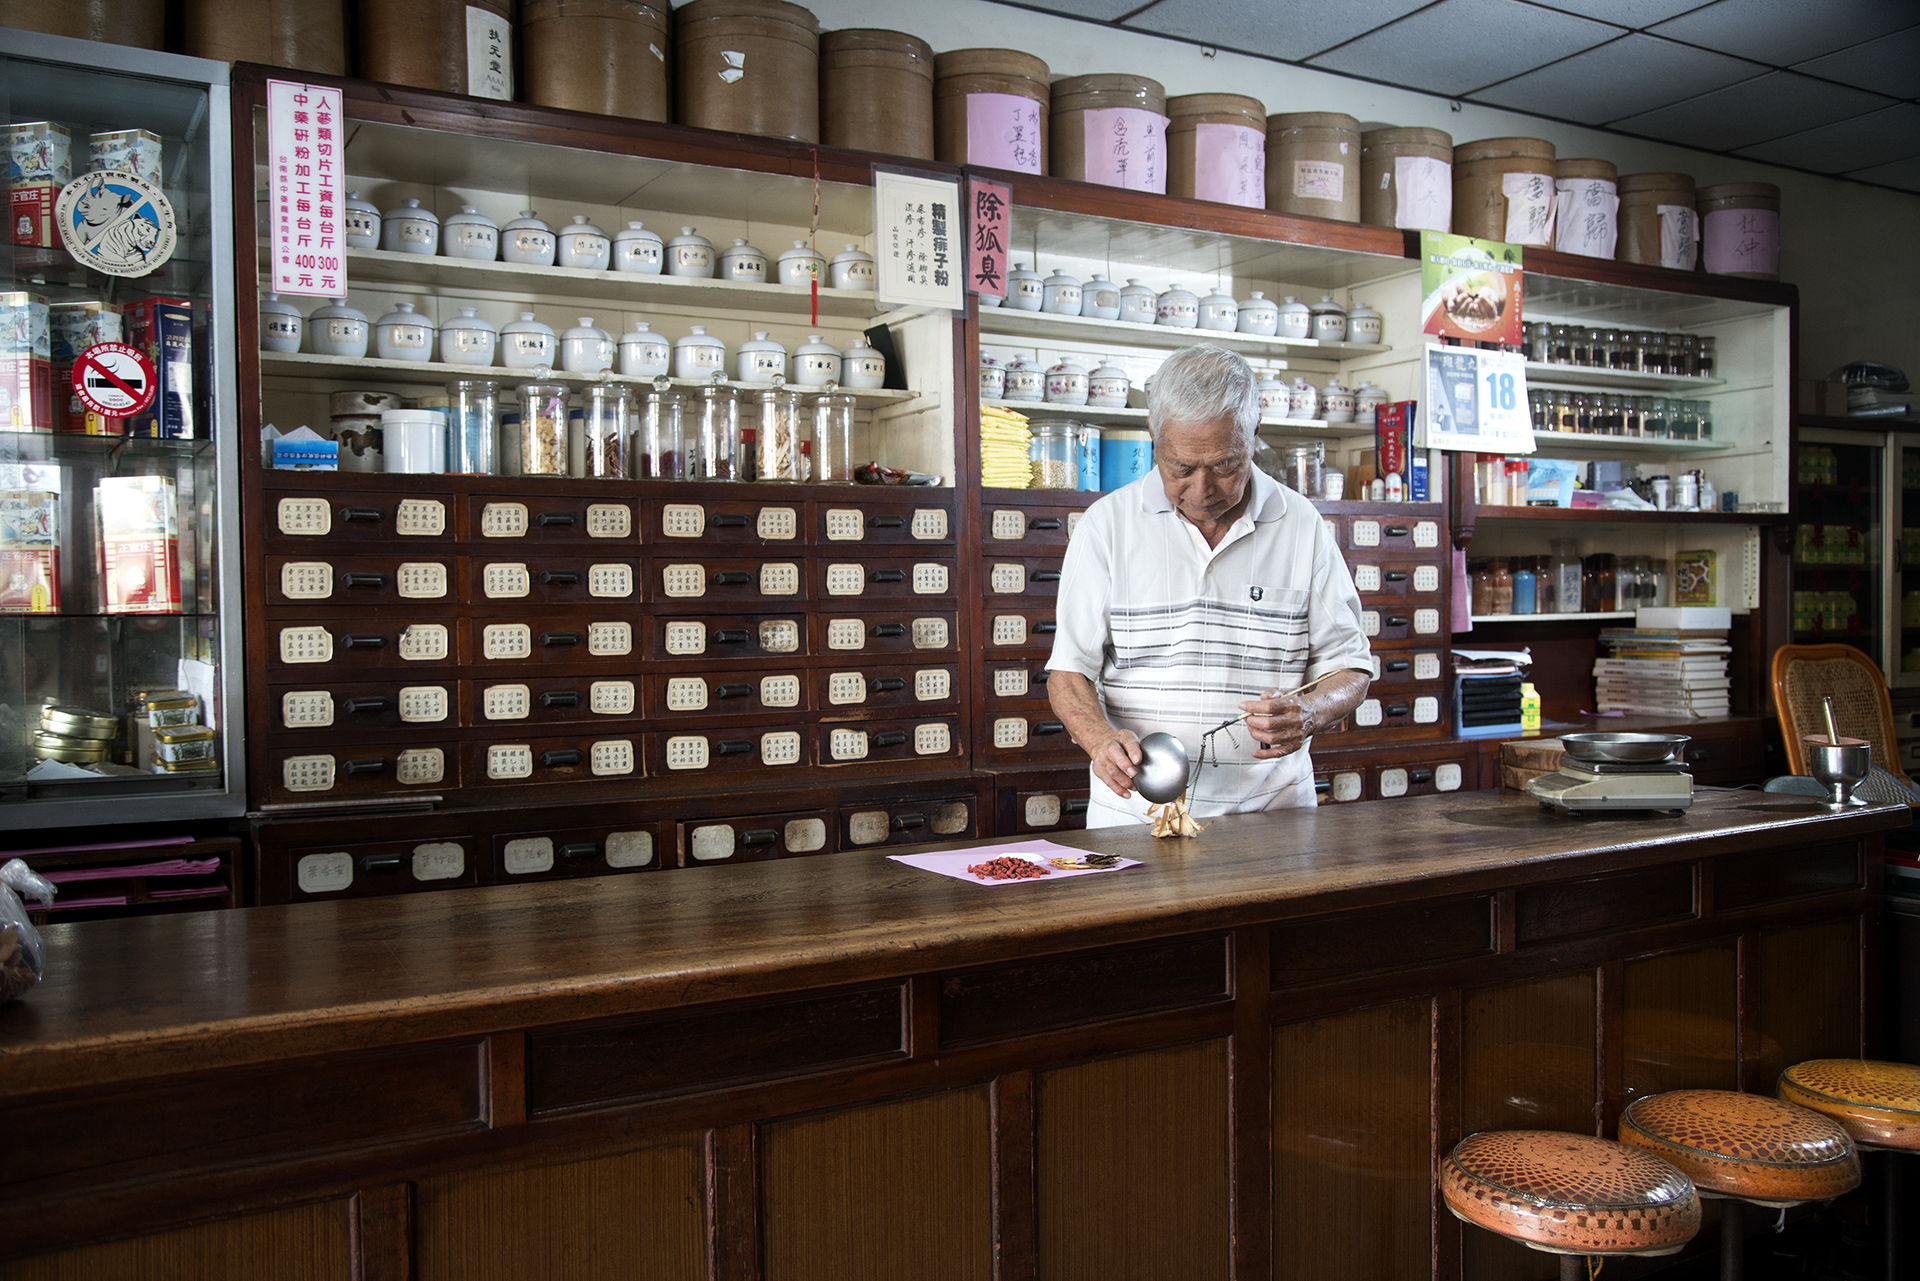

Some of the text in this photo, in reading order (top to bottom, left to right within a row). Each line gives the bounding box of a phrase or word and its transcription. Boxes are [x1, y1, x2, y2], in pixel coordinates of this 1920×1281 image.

[975, 190, 1005, 290] 除狐臭
[1486, 372, 1516, 410] 18
